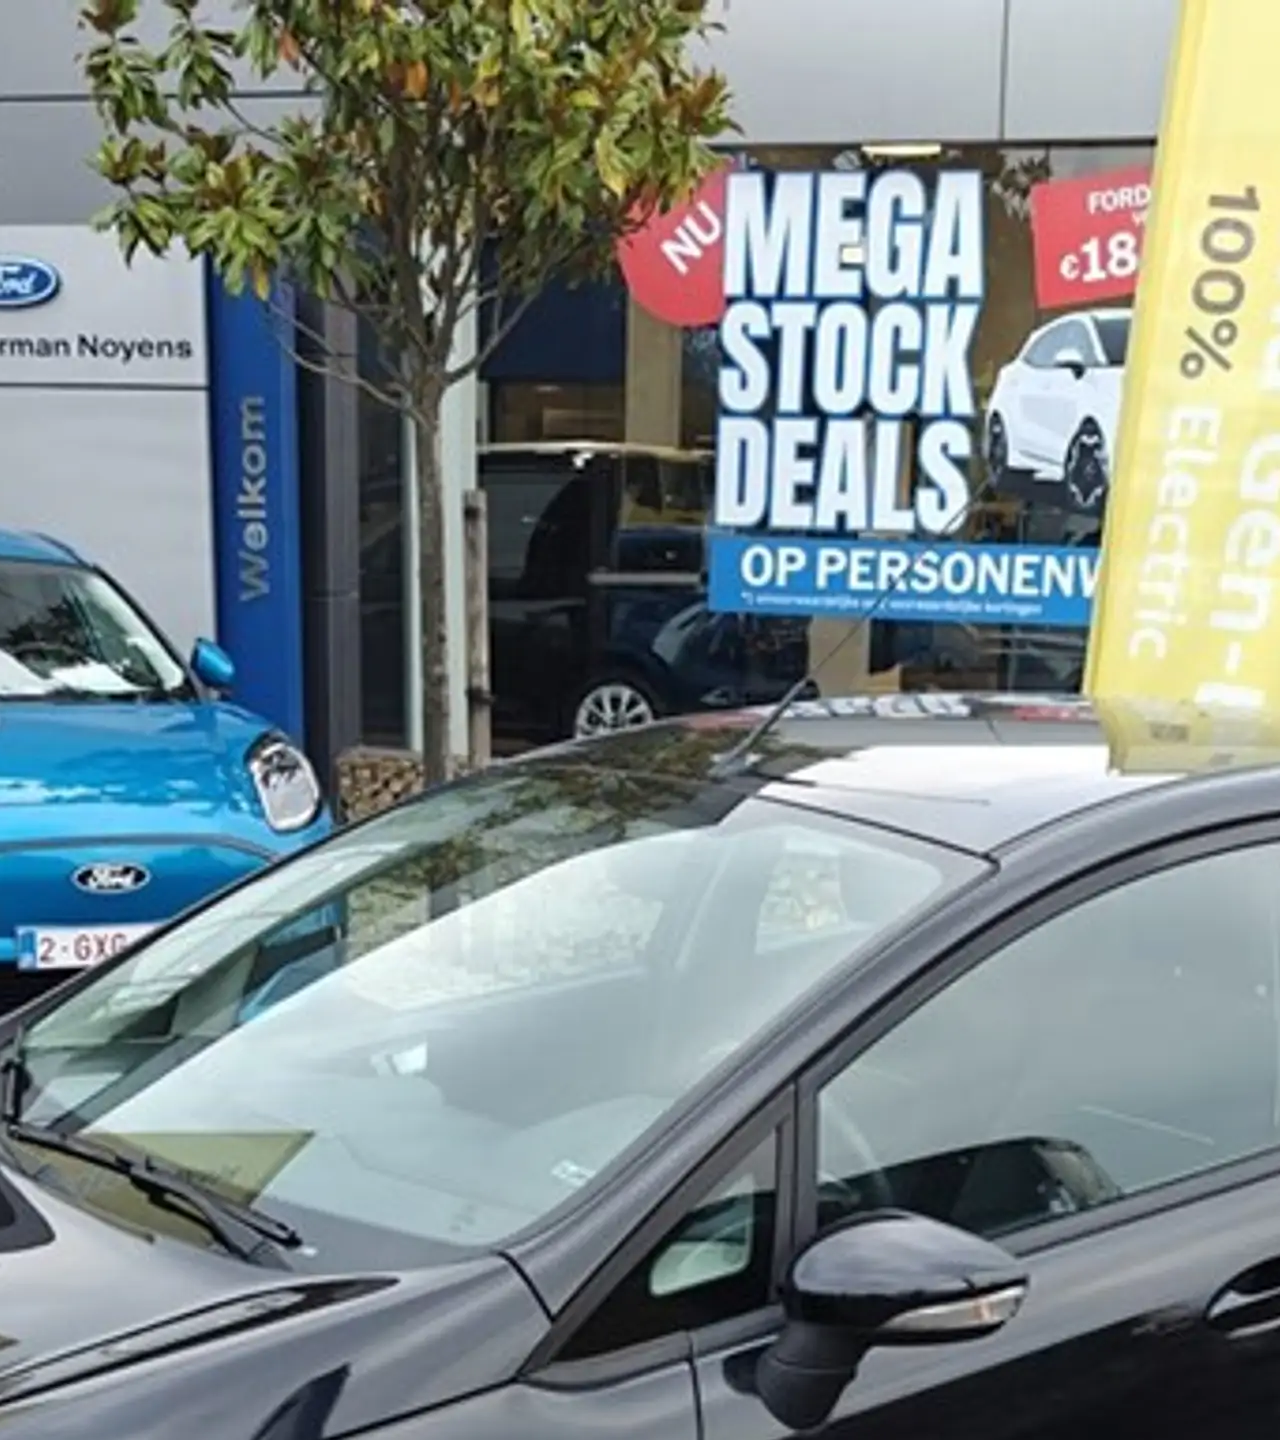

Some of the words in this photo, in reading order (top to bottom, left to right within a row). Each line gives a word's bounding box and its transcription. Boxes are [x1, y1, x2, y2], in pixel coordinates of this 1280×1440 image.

[660, 200, 722, 275] NU
[723, 168, 983, 298] MEGA
[1087, 184, 1153, 215] FORD
[1179, 185, 1261, 381] 100%
[77, 334, 193, 365] Noyens
[719, 302, 980, 416] STOCK
[237, 396, 270, 603] Welkom
[714, 416, 974, 534] DEALS
[1129, 398, 1224, 662] Electric
[740, 545, 806, 587] OP
